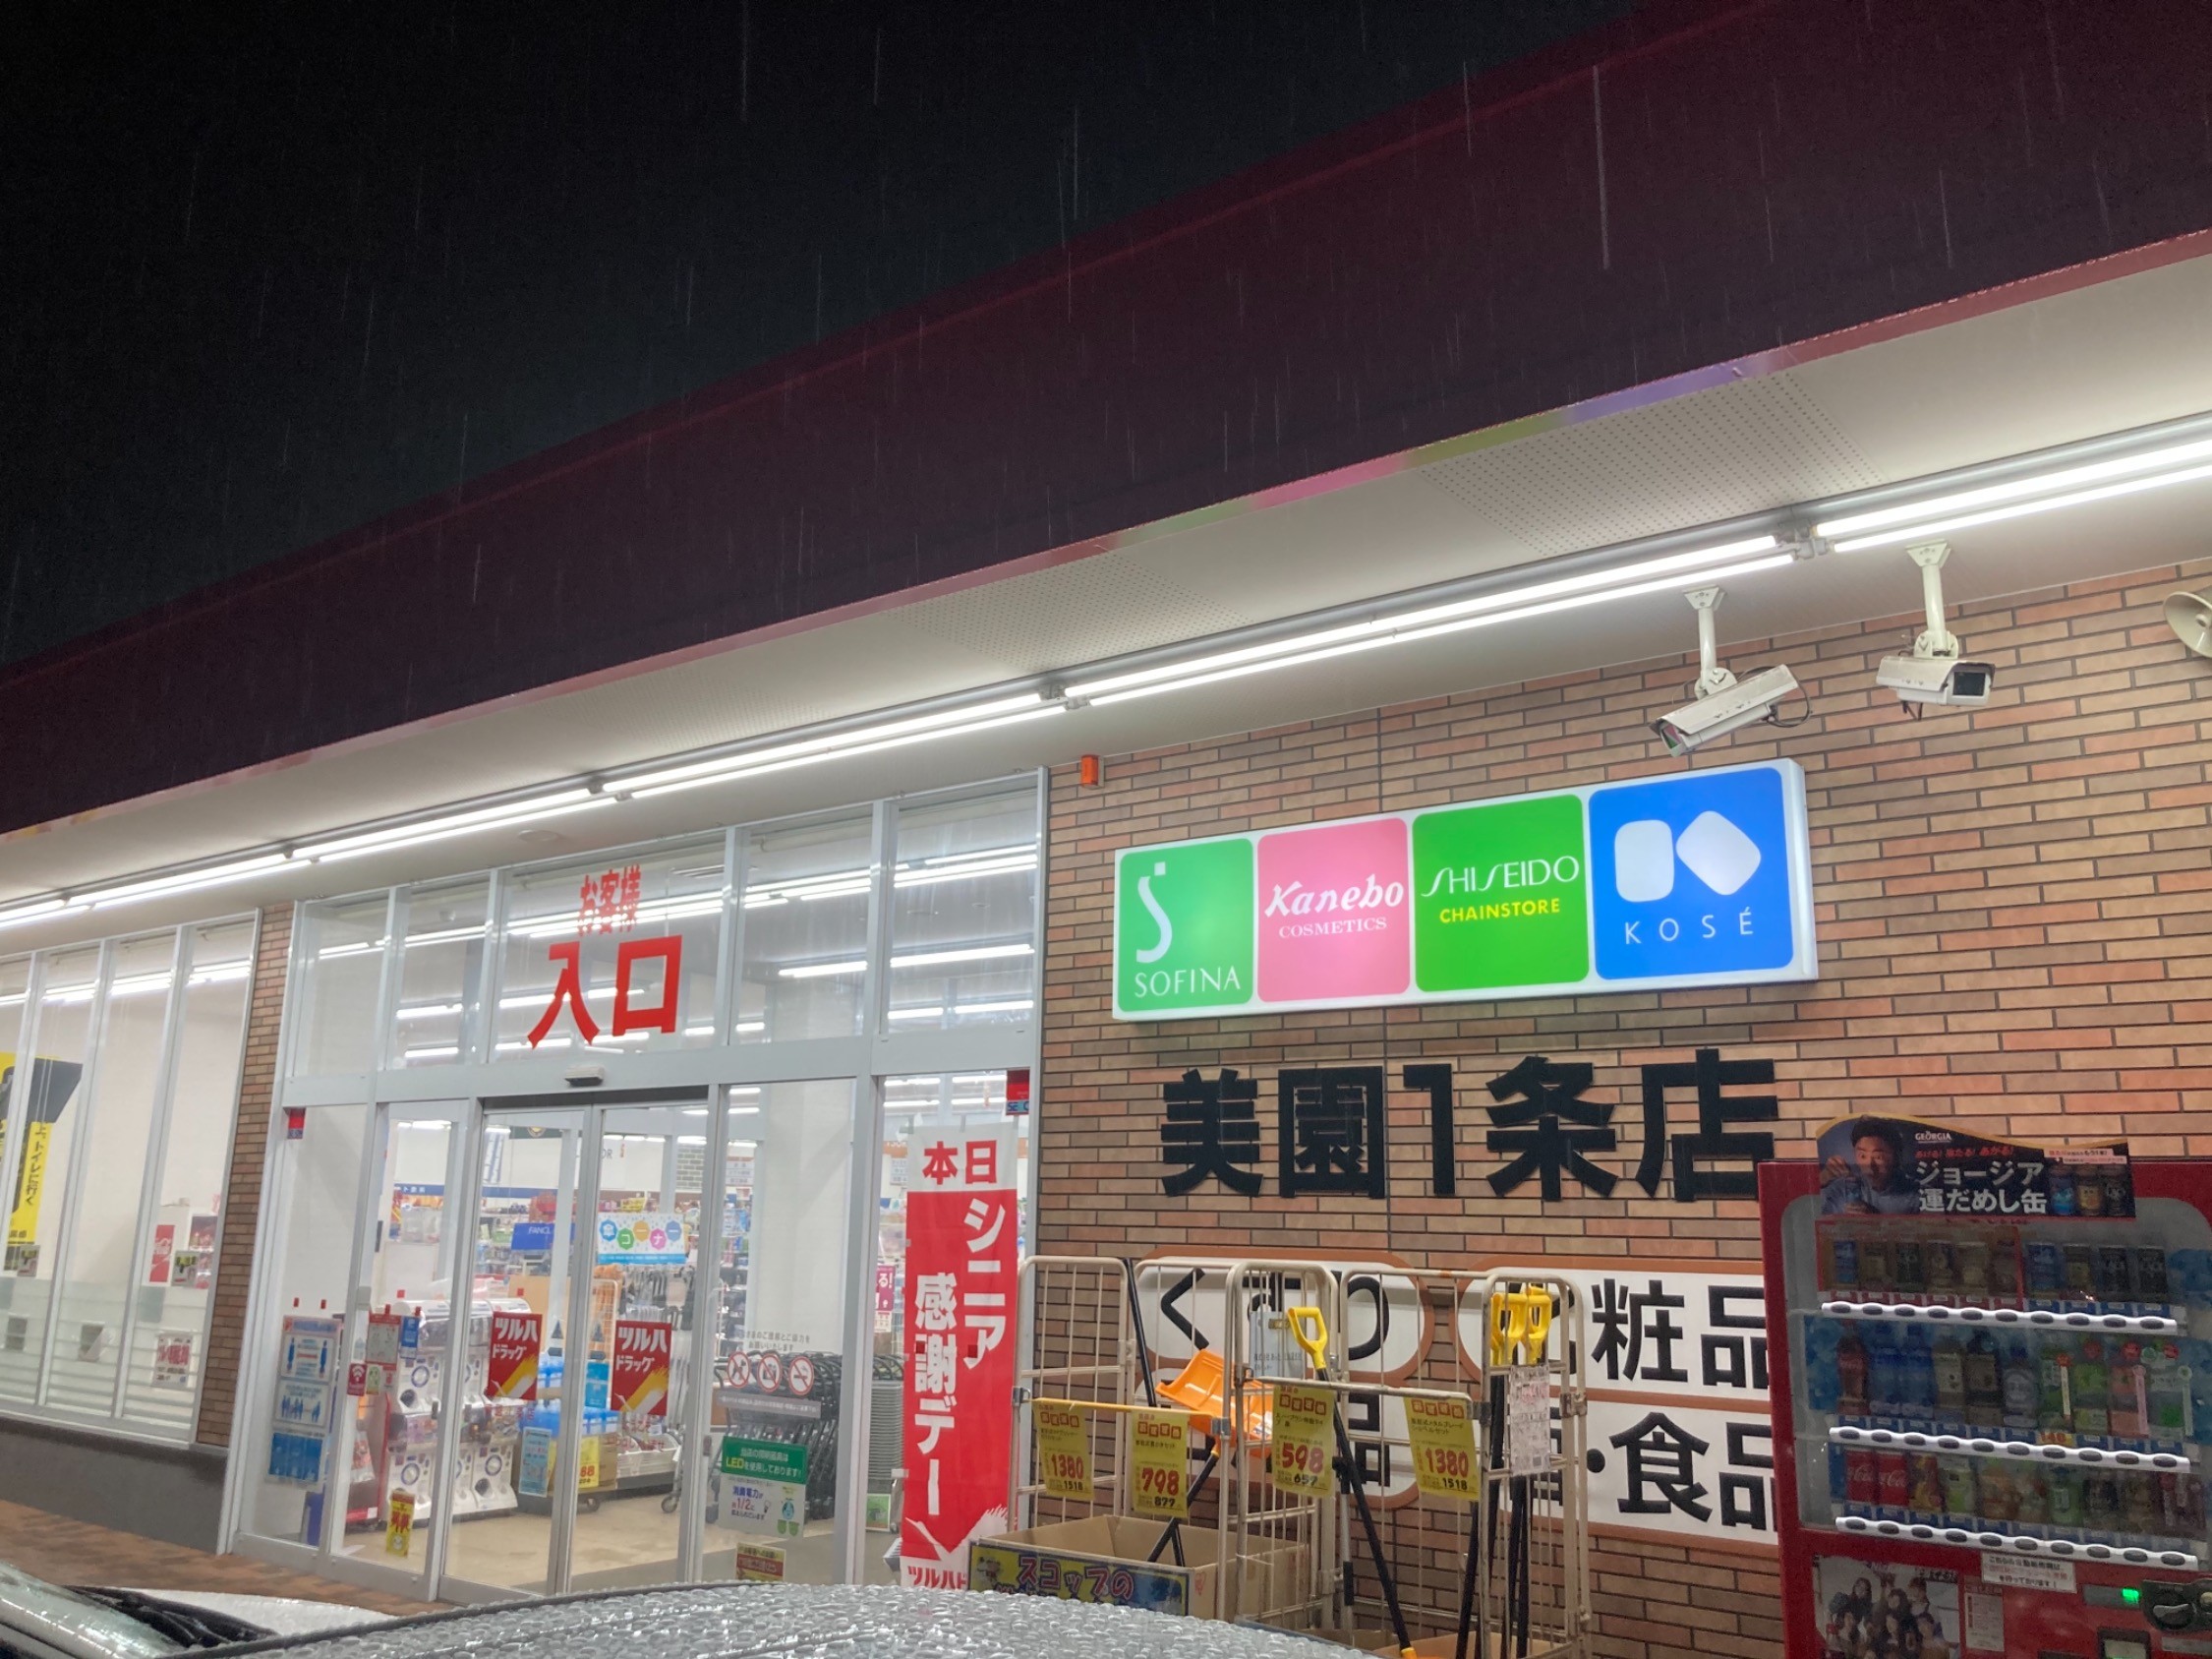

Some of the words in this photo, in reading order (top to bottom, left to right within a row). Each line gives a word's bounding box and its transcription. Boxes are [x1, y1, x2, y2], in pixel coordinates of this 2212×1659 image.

[1421, 855, 1580, 897] SHISEIDO
[1264, 873, 1404, 918] Kanebo
[1439, 898, 1560, 924] CHAINSTORE
[1279, 917, 1387, 938] COSMETICS
[1624, 907, 1754, 945] KOSÉ
[527, 935, 682, 1049] 入口
[1135, 965, 1242, 999] SOFINA
[1161, 1047, 1778, 1202] 美園1条店
[1914, 1131, 1952, 1141] GEORGIA
[922, 1140, 997, 1185] 本日
[1916, 1160, 2045, 1186] ジョージア
[1918, 1188, 2048, 1215] 運だめし缶
[963, 1197, 1007, 1370] シニア
[495, 1317, 539, 1342] ツルハ
[617, 1327, 669, 1353] ツルハ
[492, 1343, 527, 1361] ドラッグ
[615, 1354, 655, 1374] ドラッグ
[914, 1272, 959, 1516] 感謝デー
[1051, 1453, 1084, 1480] 1380
[1282, 1442, 1324, 1474] 598
[1426, 1447, 1470, 1478] 1380
[1064, 1479, 1084, 1491] 1518
[1141, 1466, 1180, 1497] 798
[1442, 1477, 1468, 1490] 1518
[1154, 1497, 1176, 1508] 877
[1018, 1554, 1135, 1601] スコップの
